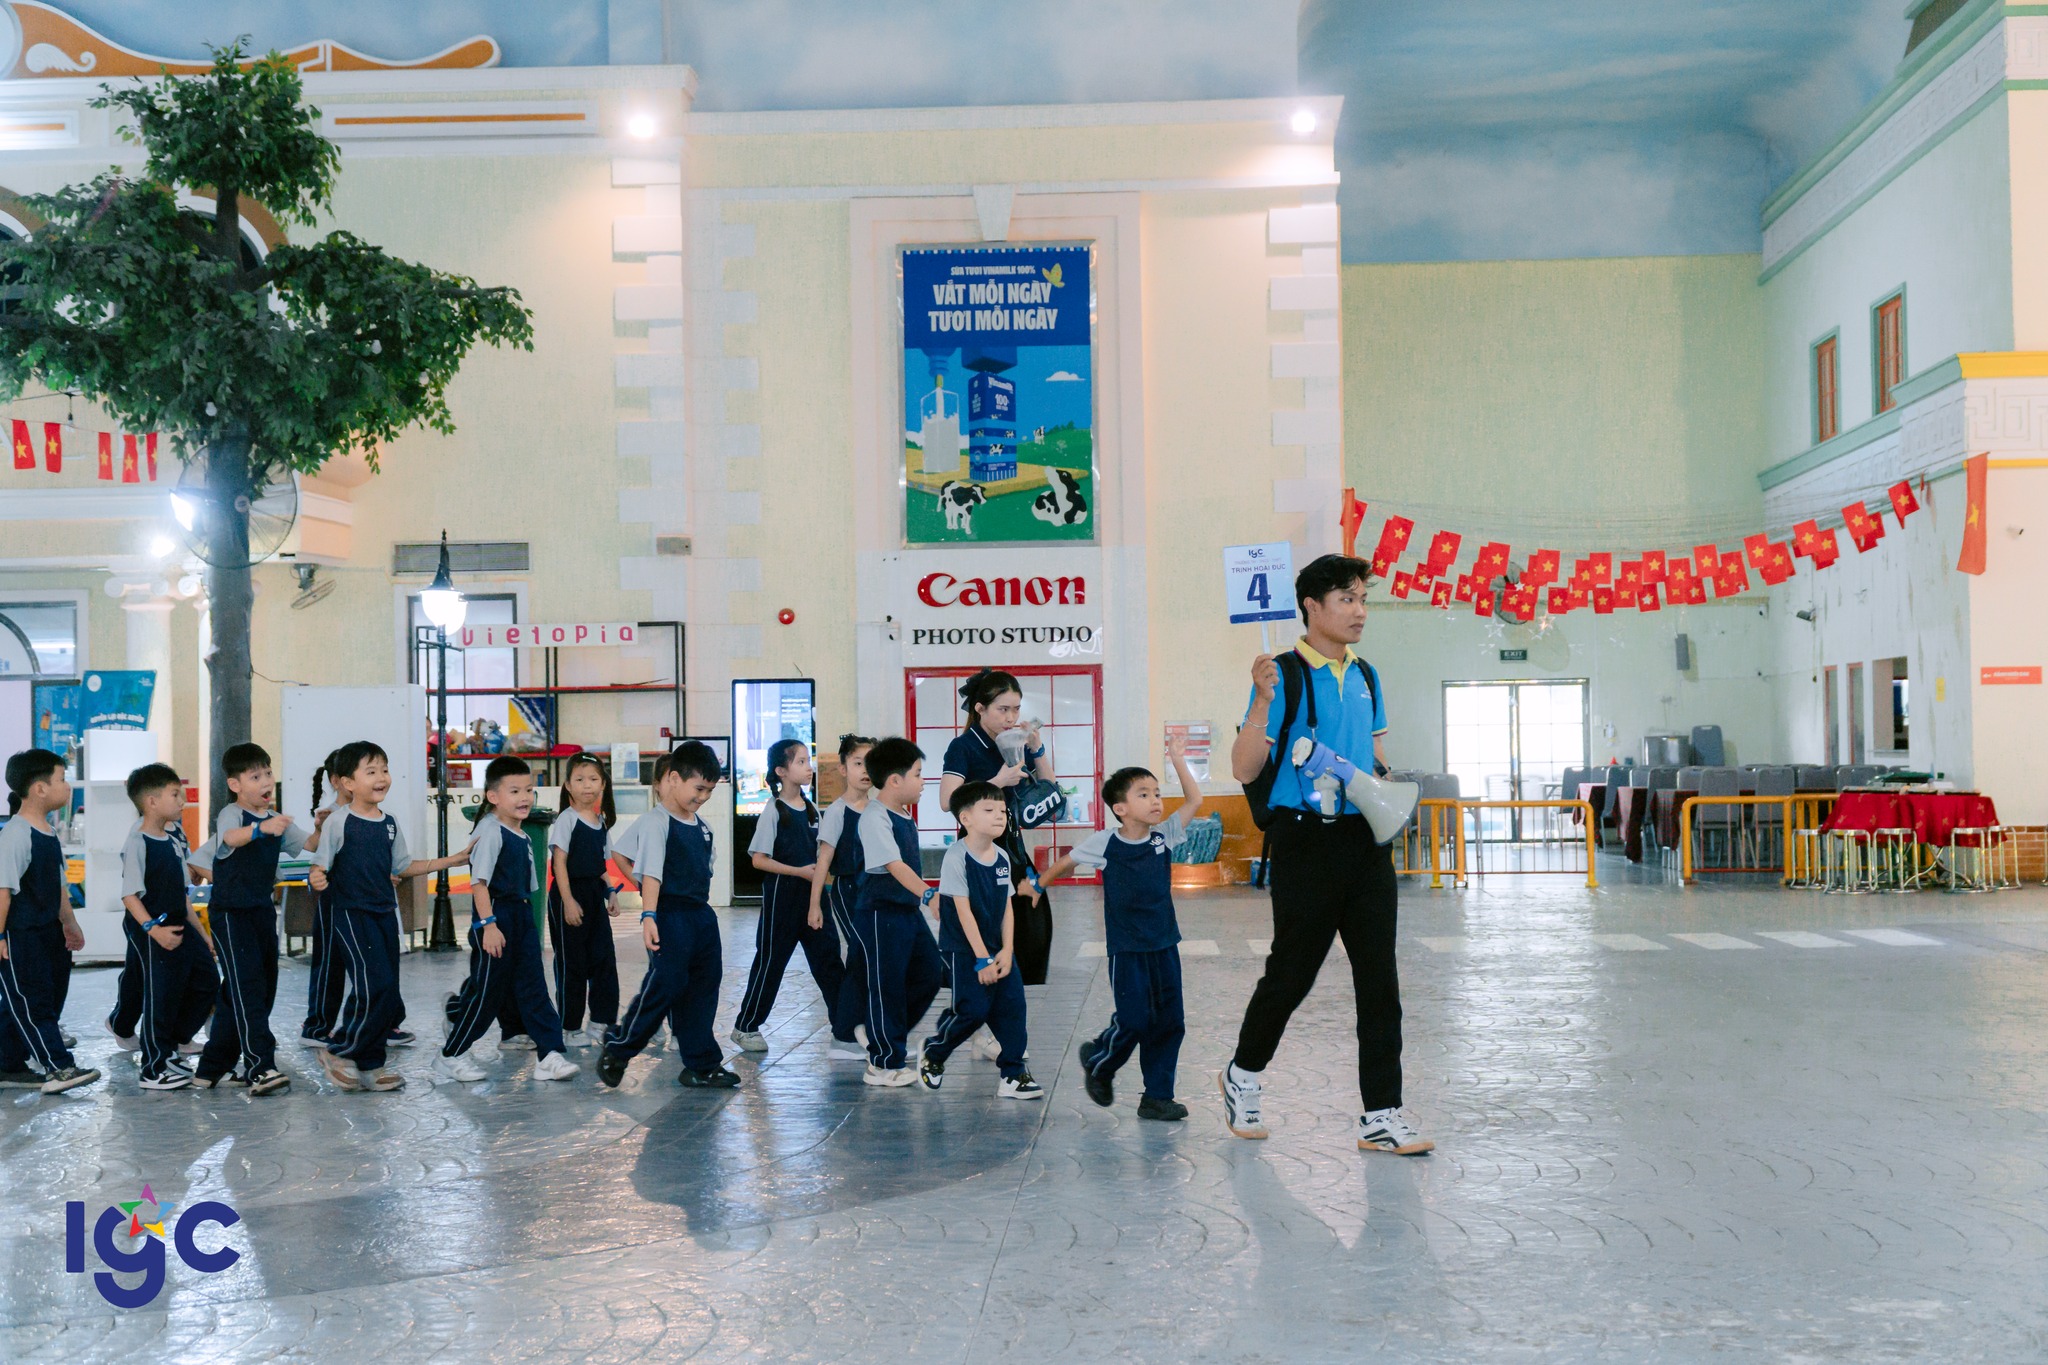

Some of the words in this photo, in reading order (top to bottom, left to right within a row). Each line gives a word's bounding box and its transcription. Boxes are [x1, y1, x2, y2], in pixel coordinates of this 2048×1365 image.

[933, 279, 966, 305] VẮT
[969, 279, 1004, 305] MỖI
[1007, 280, 1052, 304] NGÀY
[928, 310, 971, 332] TƯƠI
[975, 305, 1010, 331] MỖI
[1013, 307, 1058, 330] NGÀY
[917, 573, 1085, 607] Canon
[1247, 573, 1271, 609] 4
[913, 628, 995, 645] PHOTO
[1001, 626, 1092, 644] STUDIO
[1023, 791, 1061, 824] Cem
